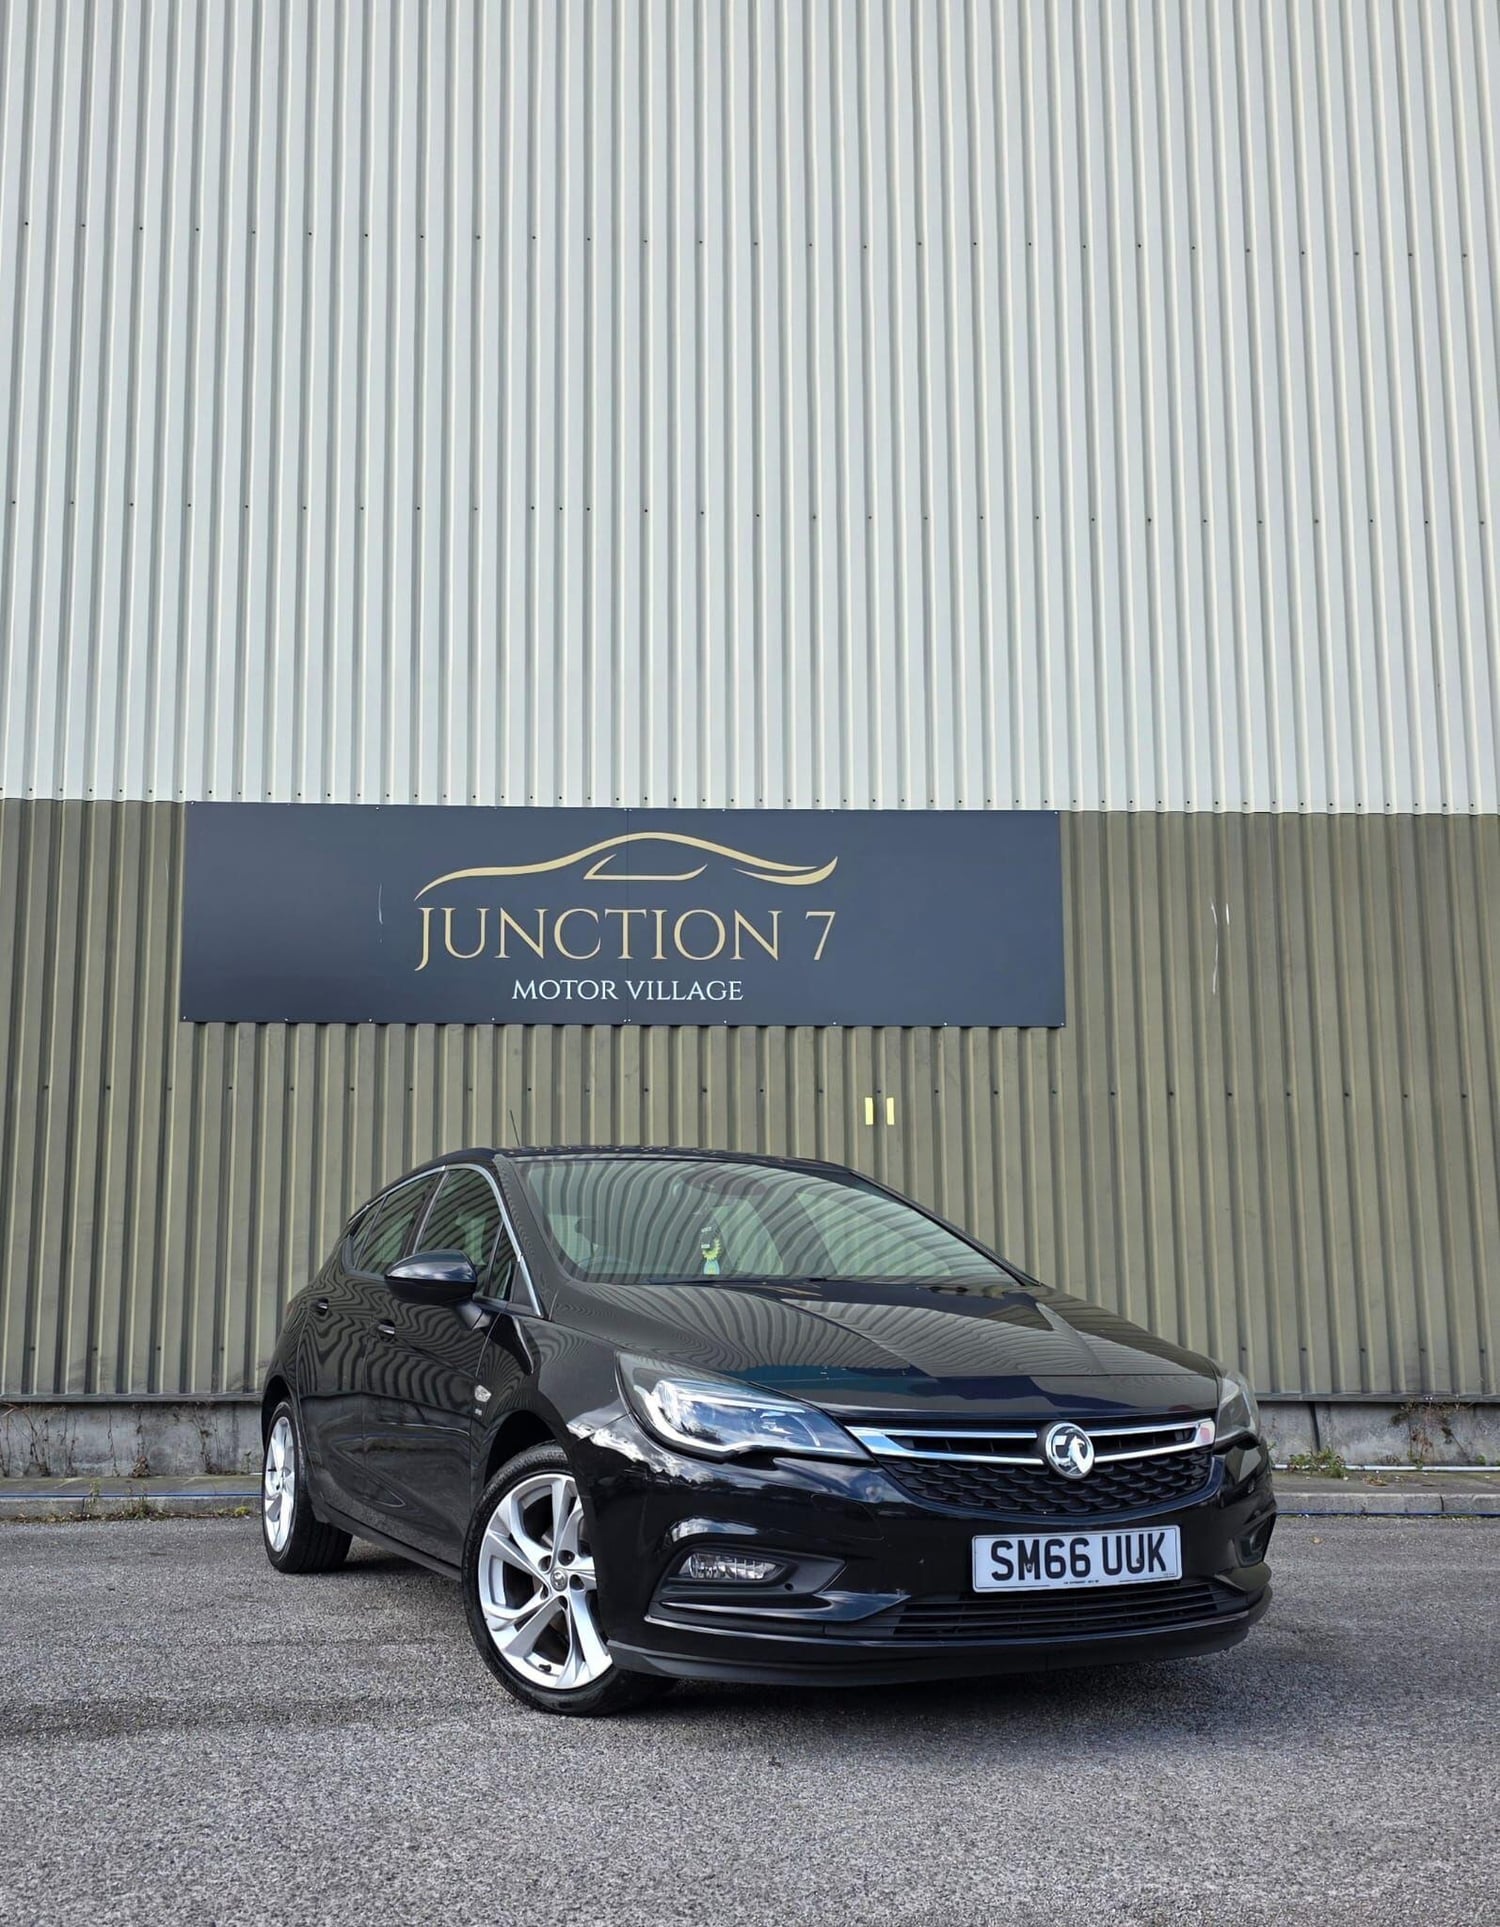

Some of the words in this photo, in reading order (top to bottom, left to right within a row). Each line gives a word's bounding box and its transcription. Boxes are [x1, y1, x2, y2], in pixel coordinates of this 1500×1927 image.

[414, 907, 782, 971] JUNCTION
[805, 911, 836, 961] 7
[511, 979, 618, 1001] MOTOR
[625, 980, 744, 1001] VILLAGE
[991, 1538, 1091, 1581] SM66
[1102, 1532, 1167, 1576] UUK
